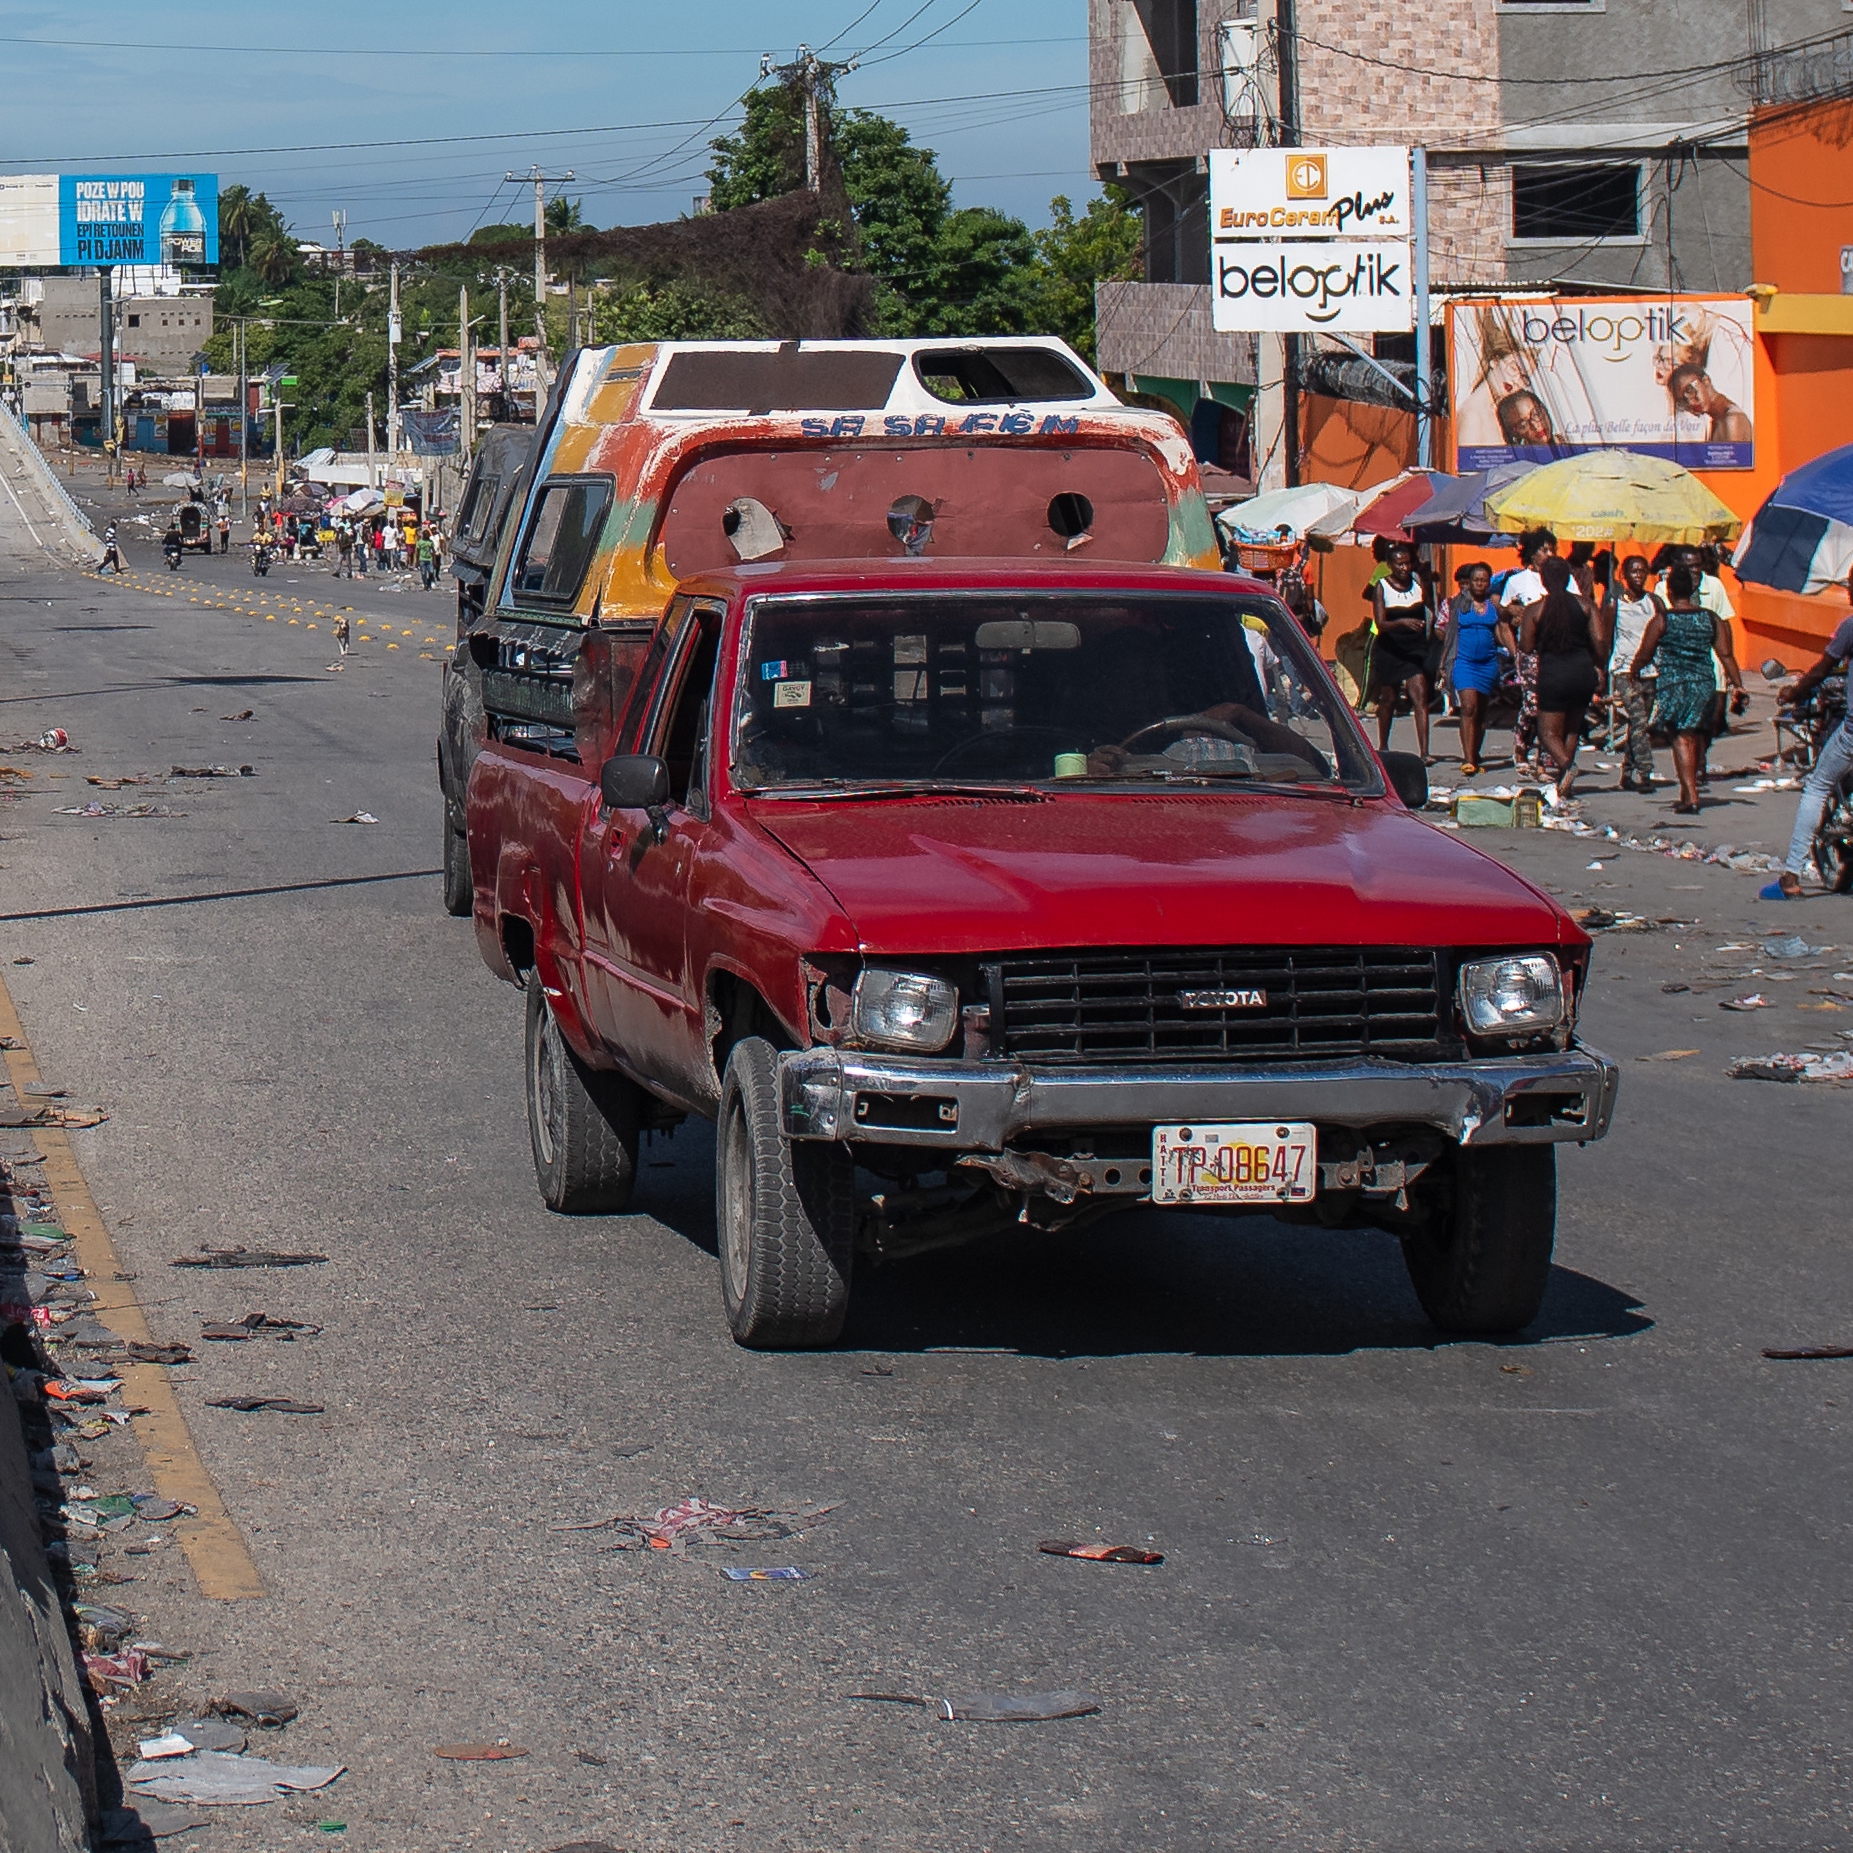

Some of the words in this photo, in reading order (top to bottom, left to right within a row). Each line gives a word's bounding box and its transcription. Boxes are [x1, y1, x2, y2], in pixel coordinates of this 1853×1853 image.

[76, 182, 105, 199] POZE
[106, 182, 120, 199] W
[121, 182, 145, 199] POU
[76, 201, 126, 222] IDRATE
[127, 200, 144, 222] W
[1329, 191, 1395, 233] Plus
[77, 223, 93, 238] EPI
[95, 223, 144, 238] RETOUNEN
[78, 240, 92, 260] PI
[96, 239, 144, 260] DJANM
[1219, 253, 1400, 309] beloptik
[1522, 306, 1688, 350] beloptik
[801, 415, 866, 437] SA
[883, 414, 946, 437] SA
[1565, 419, 1580, 434] La
[1580, 419, 1603, 437] plus
[1605, 417, 1631, 433] Belle
[1632, 417, 1662, 438] façon
[1678, 420, 1702, 433] Voir
[1185, 990, 1264, 1008] TOYOTA
[1159, 1133, 1168, 1187] HAITI
[1171, 1145, 1307, 1184] TP-08647
